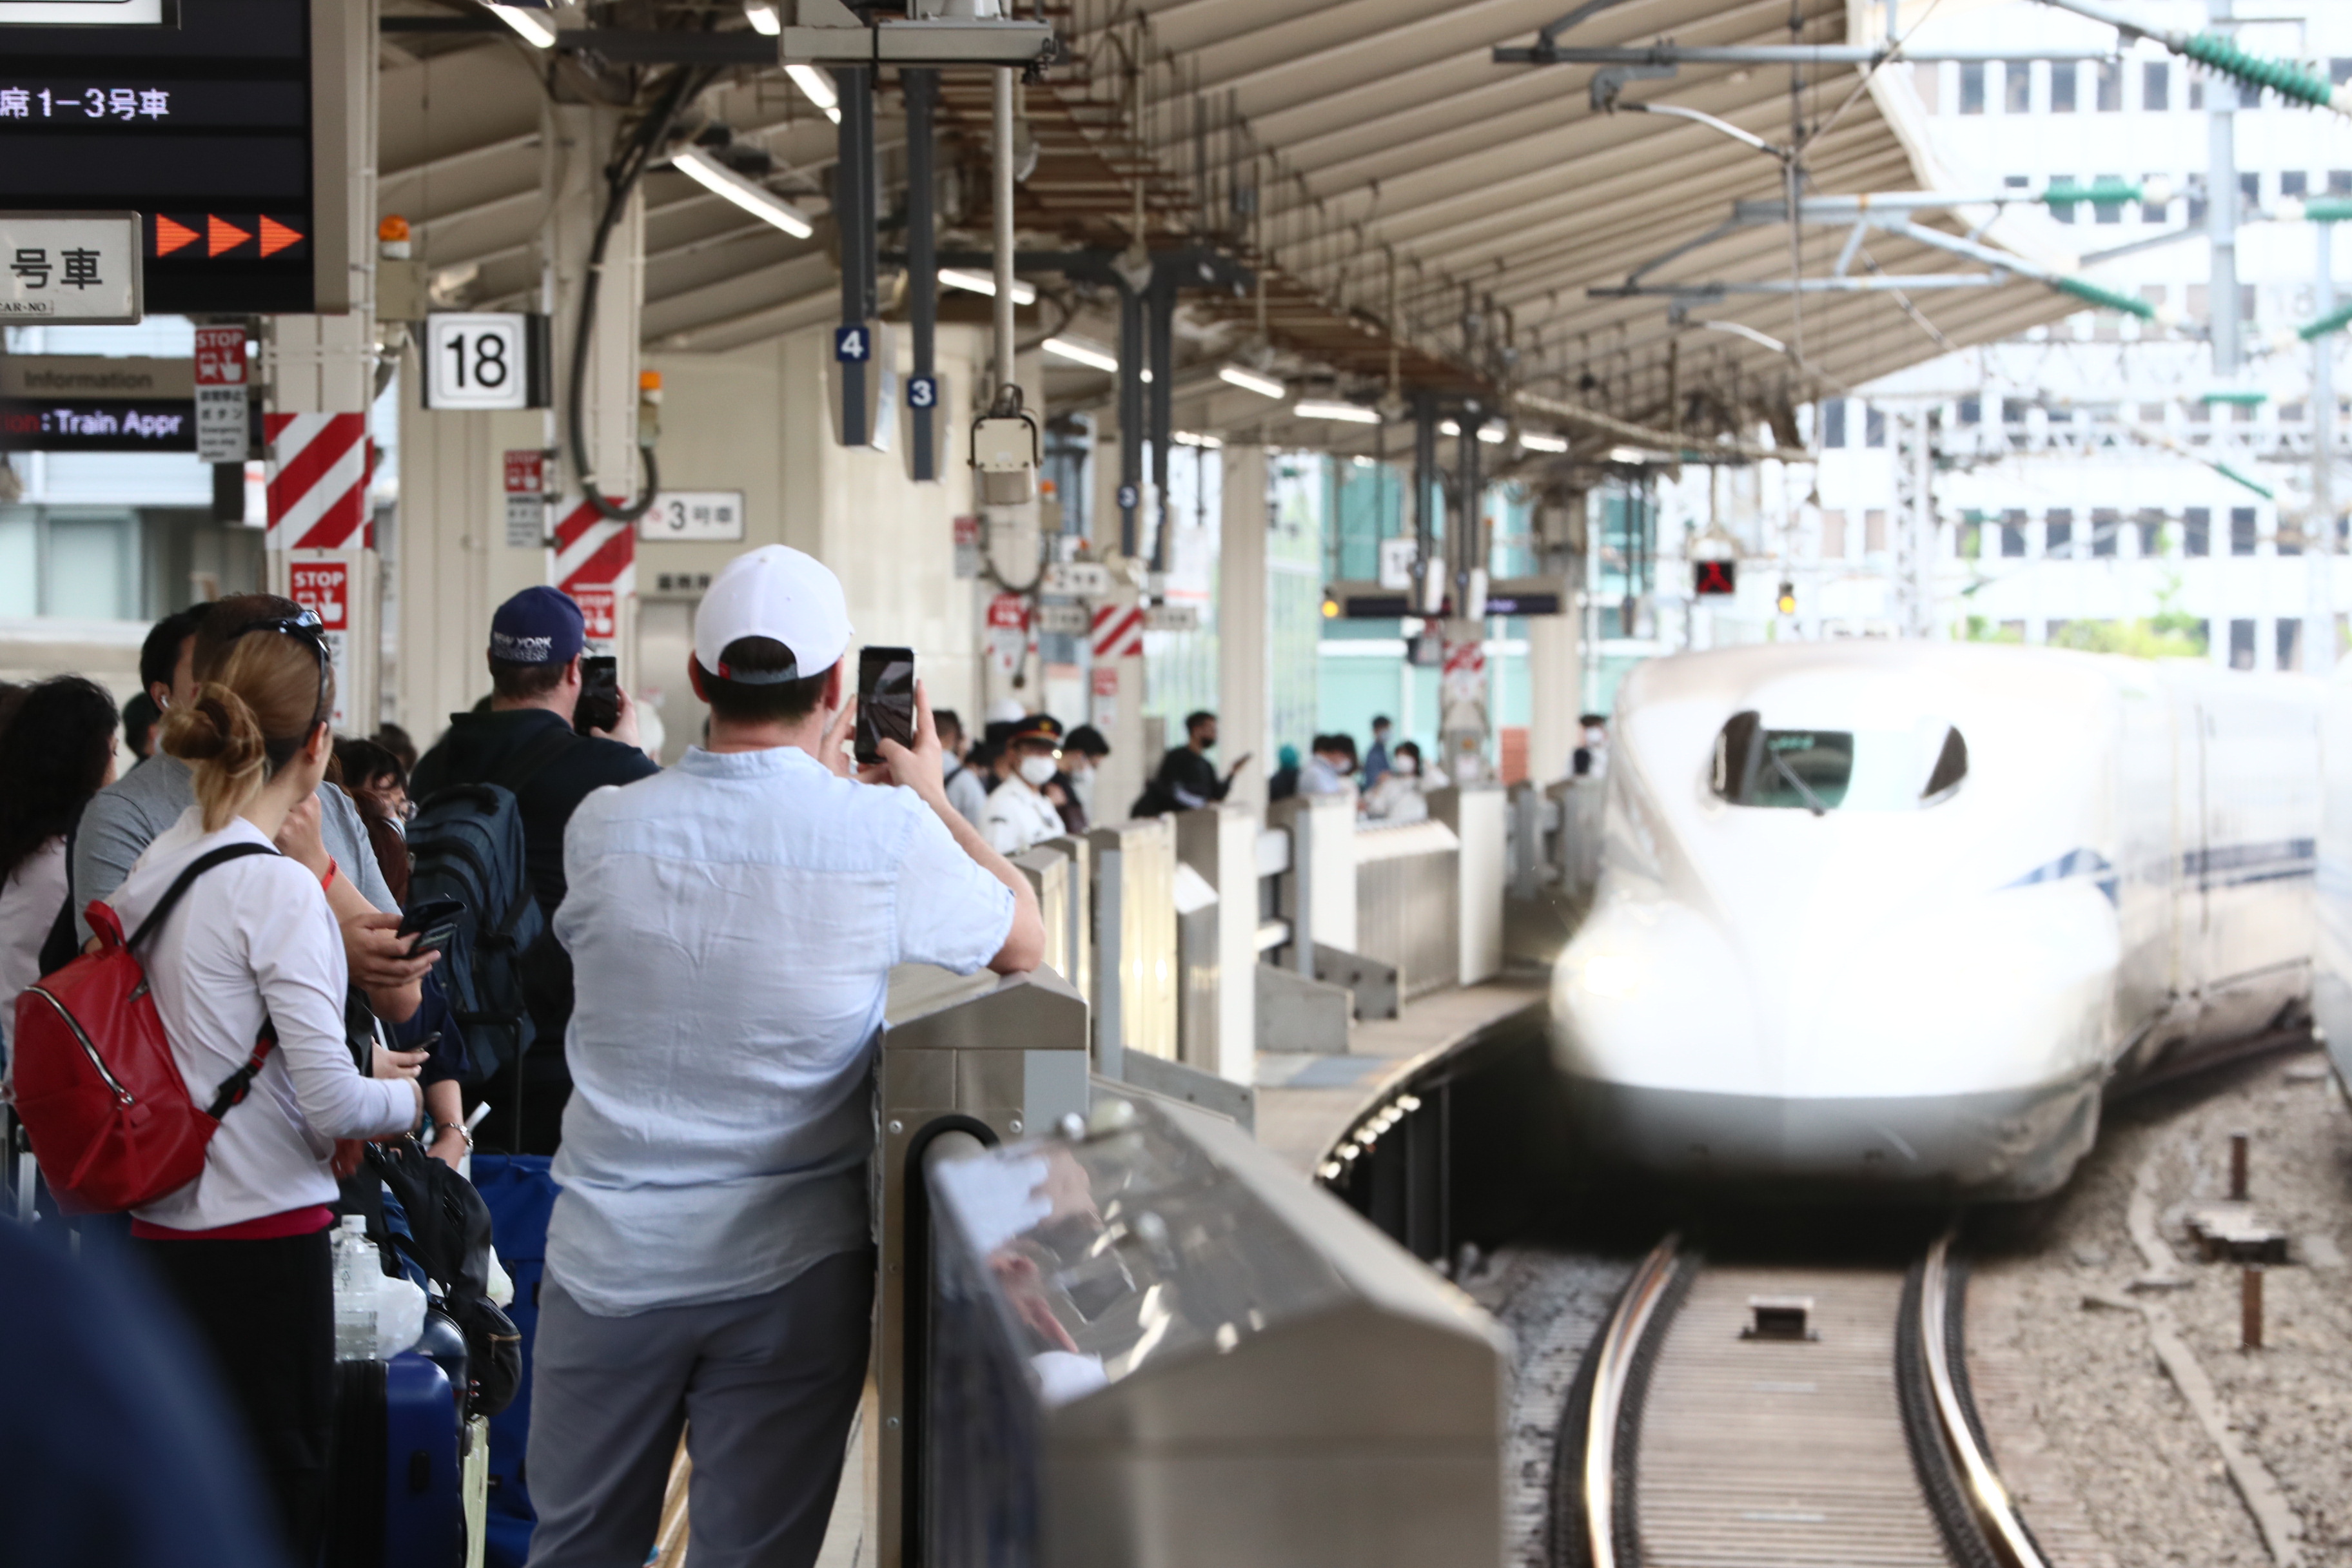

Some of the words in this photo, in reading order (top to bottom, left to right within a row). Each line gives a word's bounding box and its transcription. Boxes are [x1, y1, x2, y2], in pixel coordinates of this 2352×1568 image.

[10, 247, 103, 290] 号車
[196, 332, 243, 348] STOP
[840, 330, 865, 358] 4
[446, 333, 507, 388] 18
[912, 379, 932, 406] 3
[53, 408, 119, 435] Train
[294, 571, 345, 587] STOP
[516, 636, 552, 649] YORK
